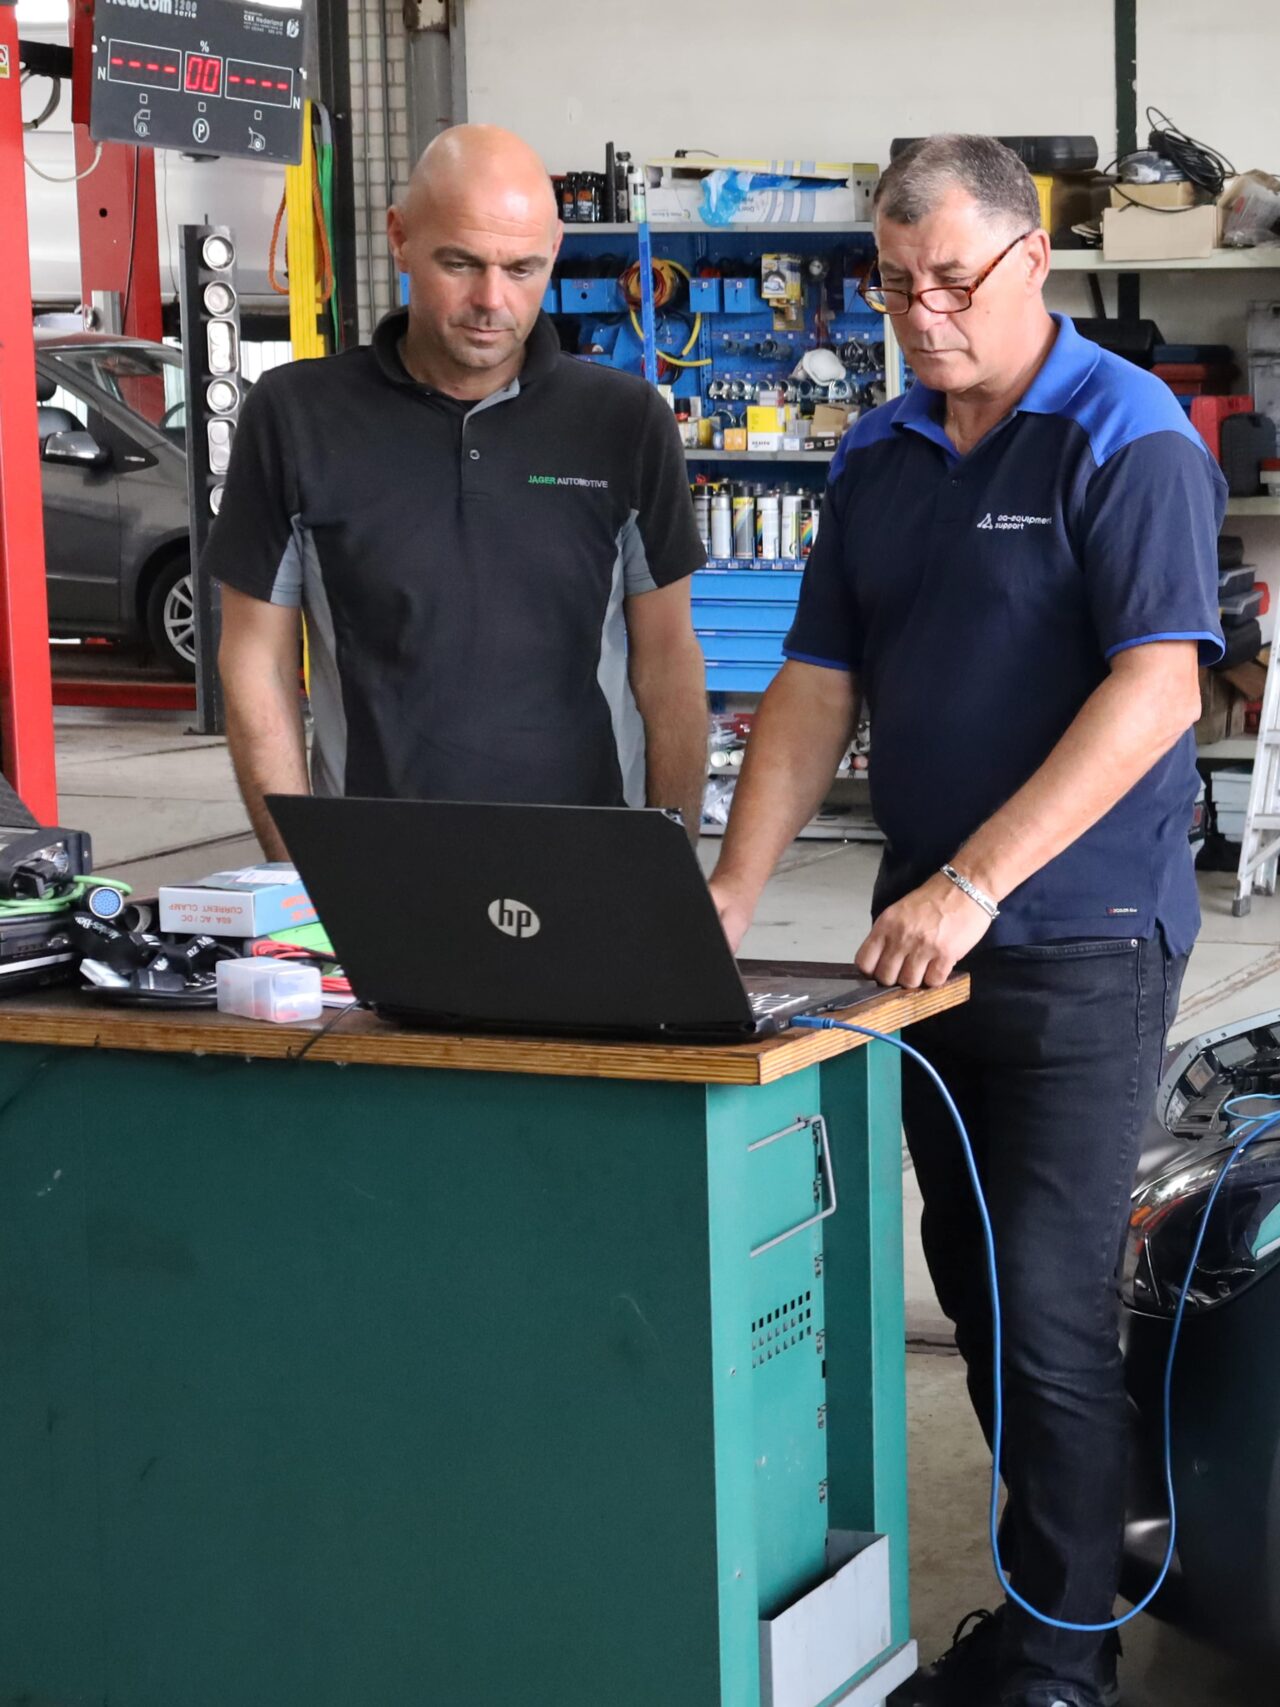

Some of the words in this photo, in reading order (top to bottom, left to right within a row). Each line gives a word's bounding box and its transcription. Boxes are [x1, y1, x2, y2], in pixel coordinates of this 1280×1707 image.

[97, 66, 106, 81] N
[293, 98, 300, 110] N
[994, 522, 1025, 530] support
[202, 905, 243, 915] CURRENT
[497, 898, 532, 938] hp
